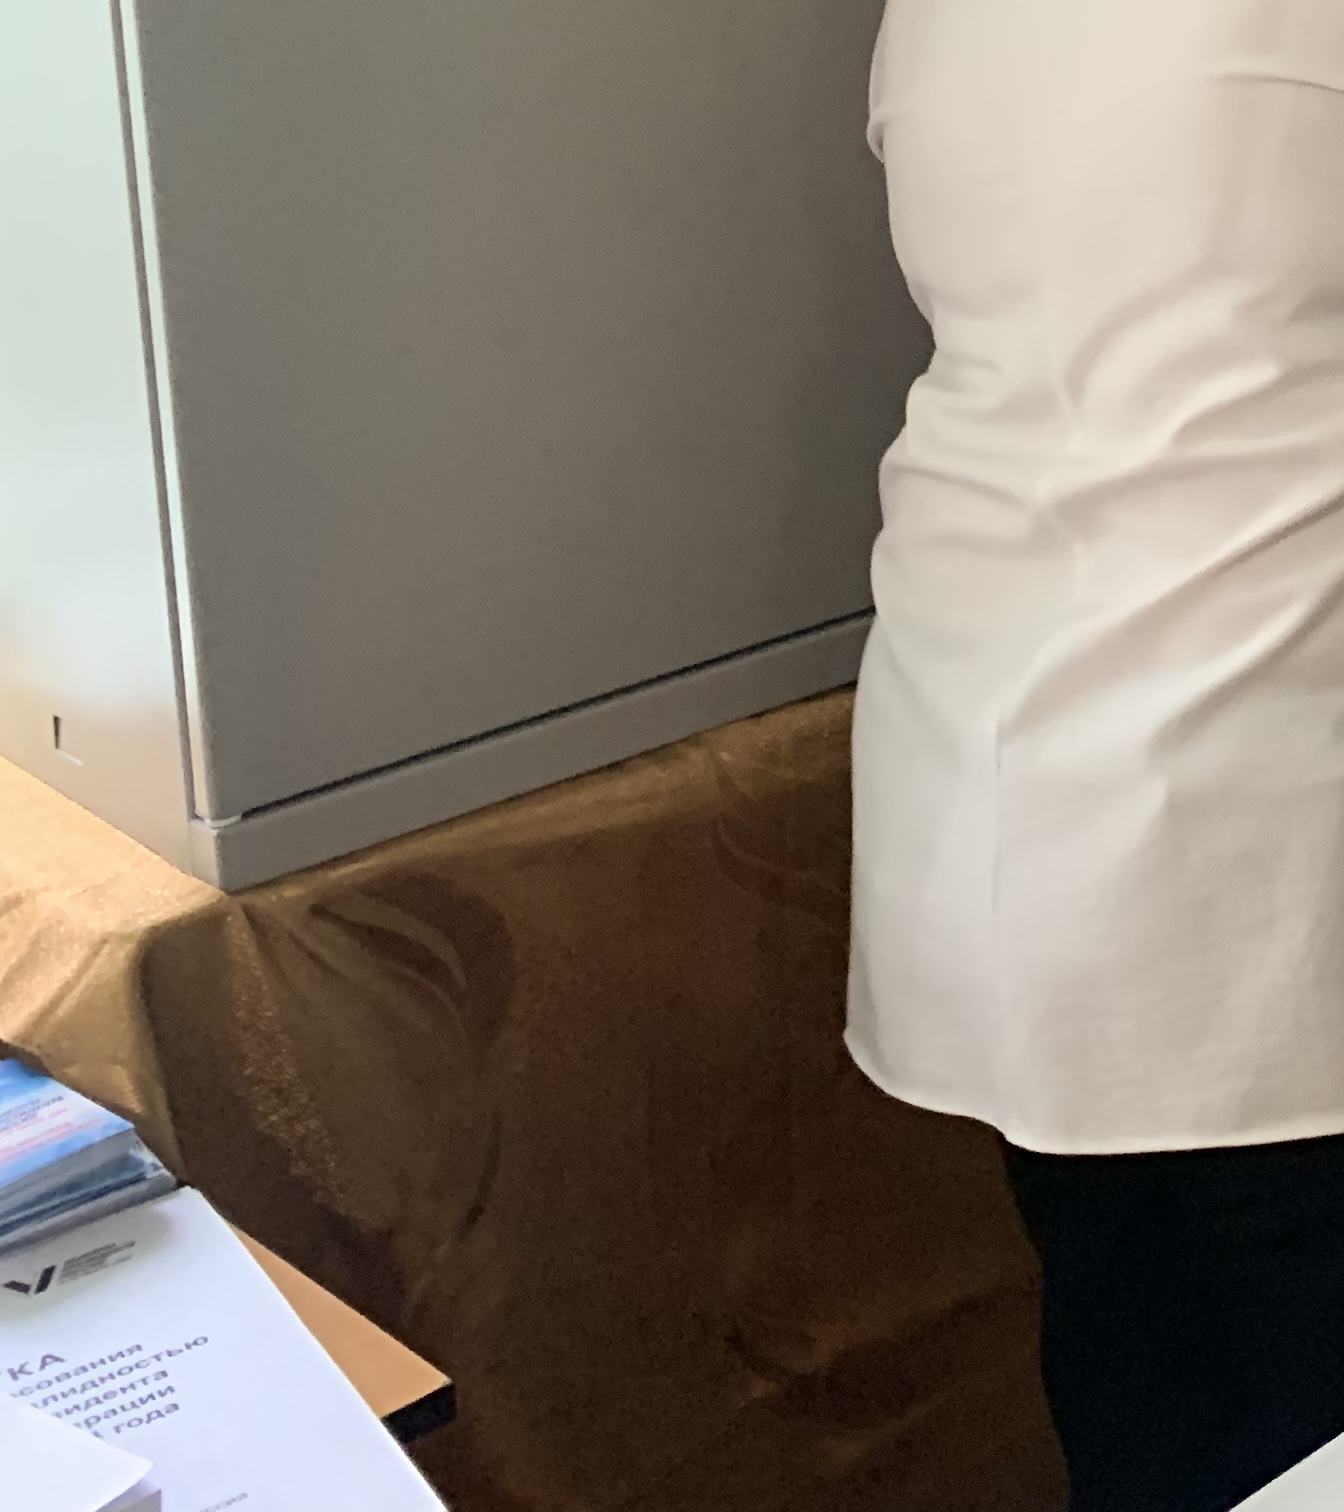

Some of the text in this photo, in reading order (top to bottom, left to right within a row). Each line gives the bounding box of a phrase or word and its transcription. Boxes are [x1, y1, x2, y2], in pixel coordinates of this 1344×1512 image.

[10, 1344, 143, 1398] сования
[30, 1336, 209, 1409] лидностью
[113, 1402, 180, 1433] года
